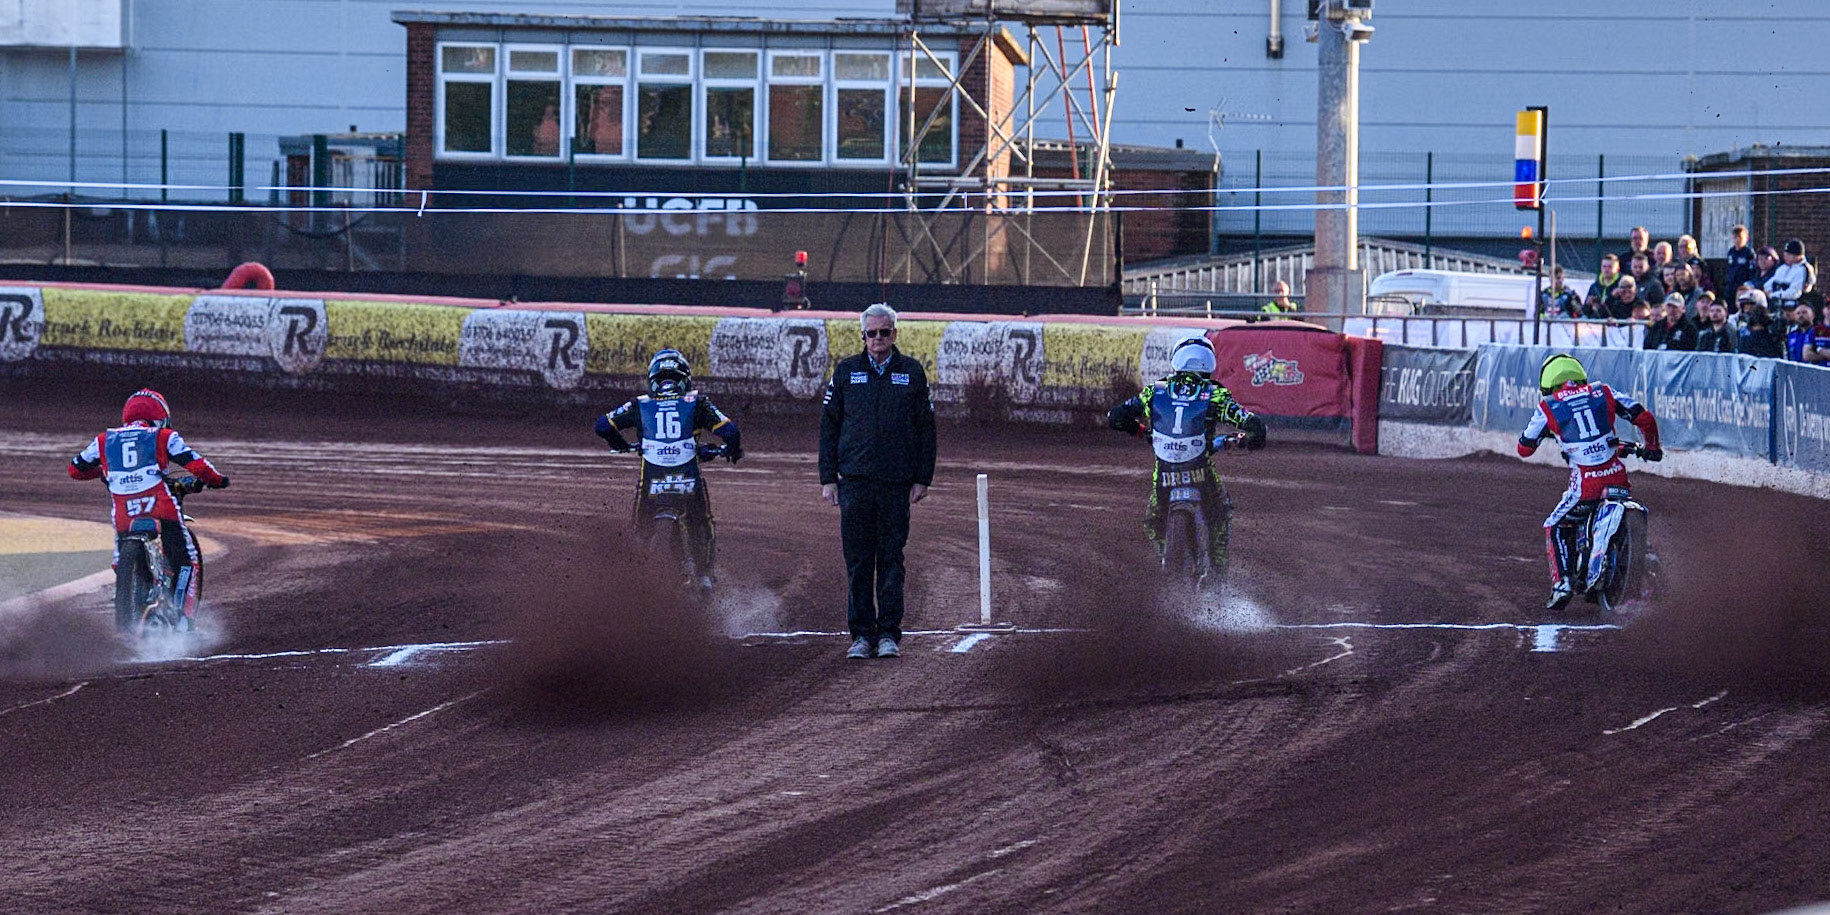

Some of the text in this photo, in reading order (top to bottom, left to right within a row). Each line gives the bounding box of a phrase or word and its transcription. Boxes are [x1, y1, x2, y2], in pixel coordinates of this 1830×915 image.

[624, 197, 758, 236] UCFB
[279, 306, 317, 354] R
[545, 319, 579, 370] R
[787, 326, 819, 378] R
[1009, 329, 1036, 383] R
[1398, 367, 1422, 406] RUG
[655, 411, 682, 439] 16
[1171, 406, 1184, 434] 1
[1573, 409, 1600, 439] 11
[122, 441, 138, 469] 6
[656, 446, 681, 455] attis
[1163, 442, 1188, 452] attis
[1582, 443, 1606, 455] attis
[119, 473, 144, 485] attis
[126, 496, 157, 517] 57
